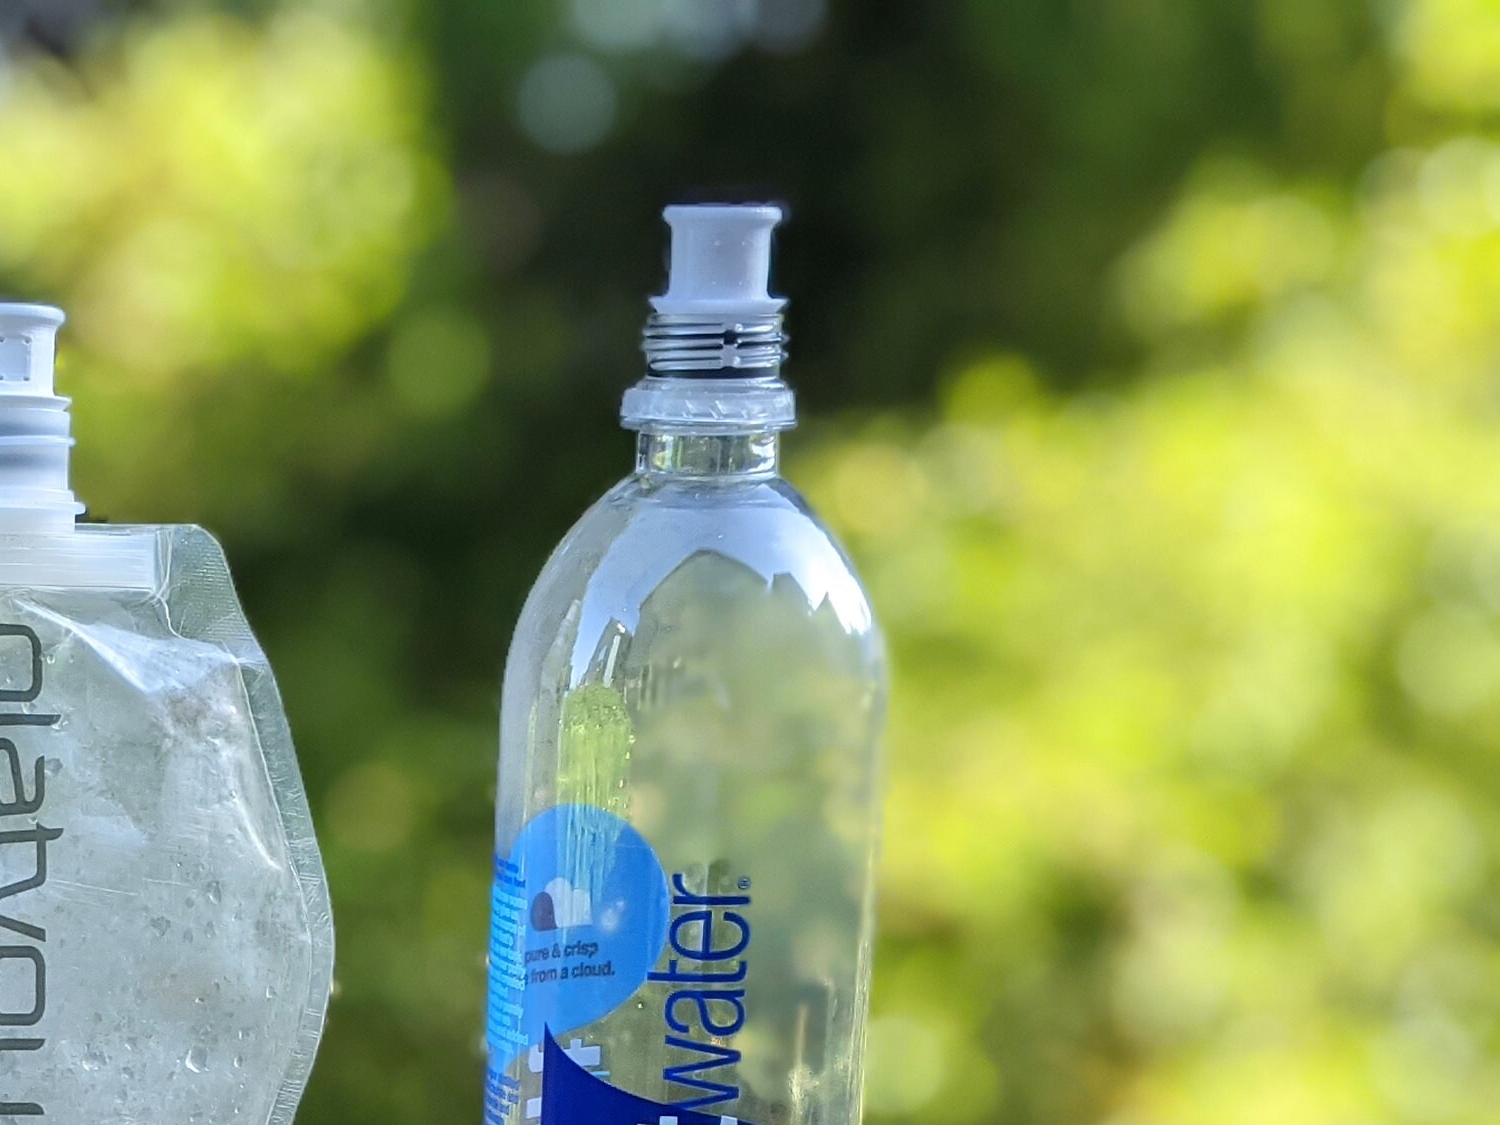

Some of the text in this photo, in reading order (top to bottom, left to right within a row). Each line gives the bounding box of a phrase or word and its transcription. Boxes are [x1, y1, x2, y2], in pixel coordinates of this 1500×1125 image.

[551, 943, 561, 959] &
[564, 940, 598, 959] crisp
[530, 967, 558, 984] from
[560, 966, 569, 980] a
[571, 960, 616, 978] cloud.
